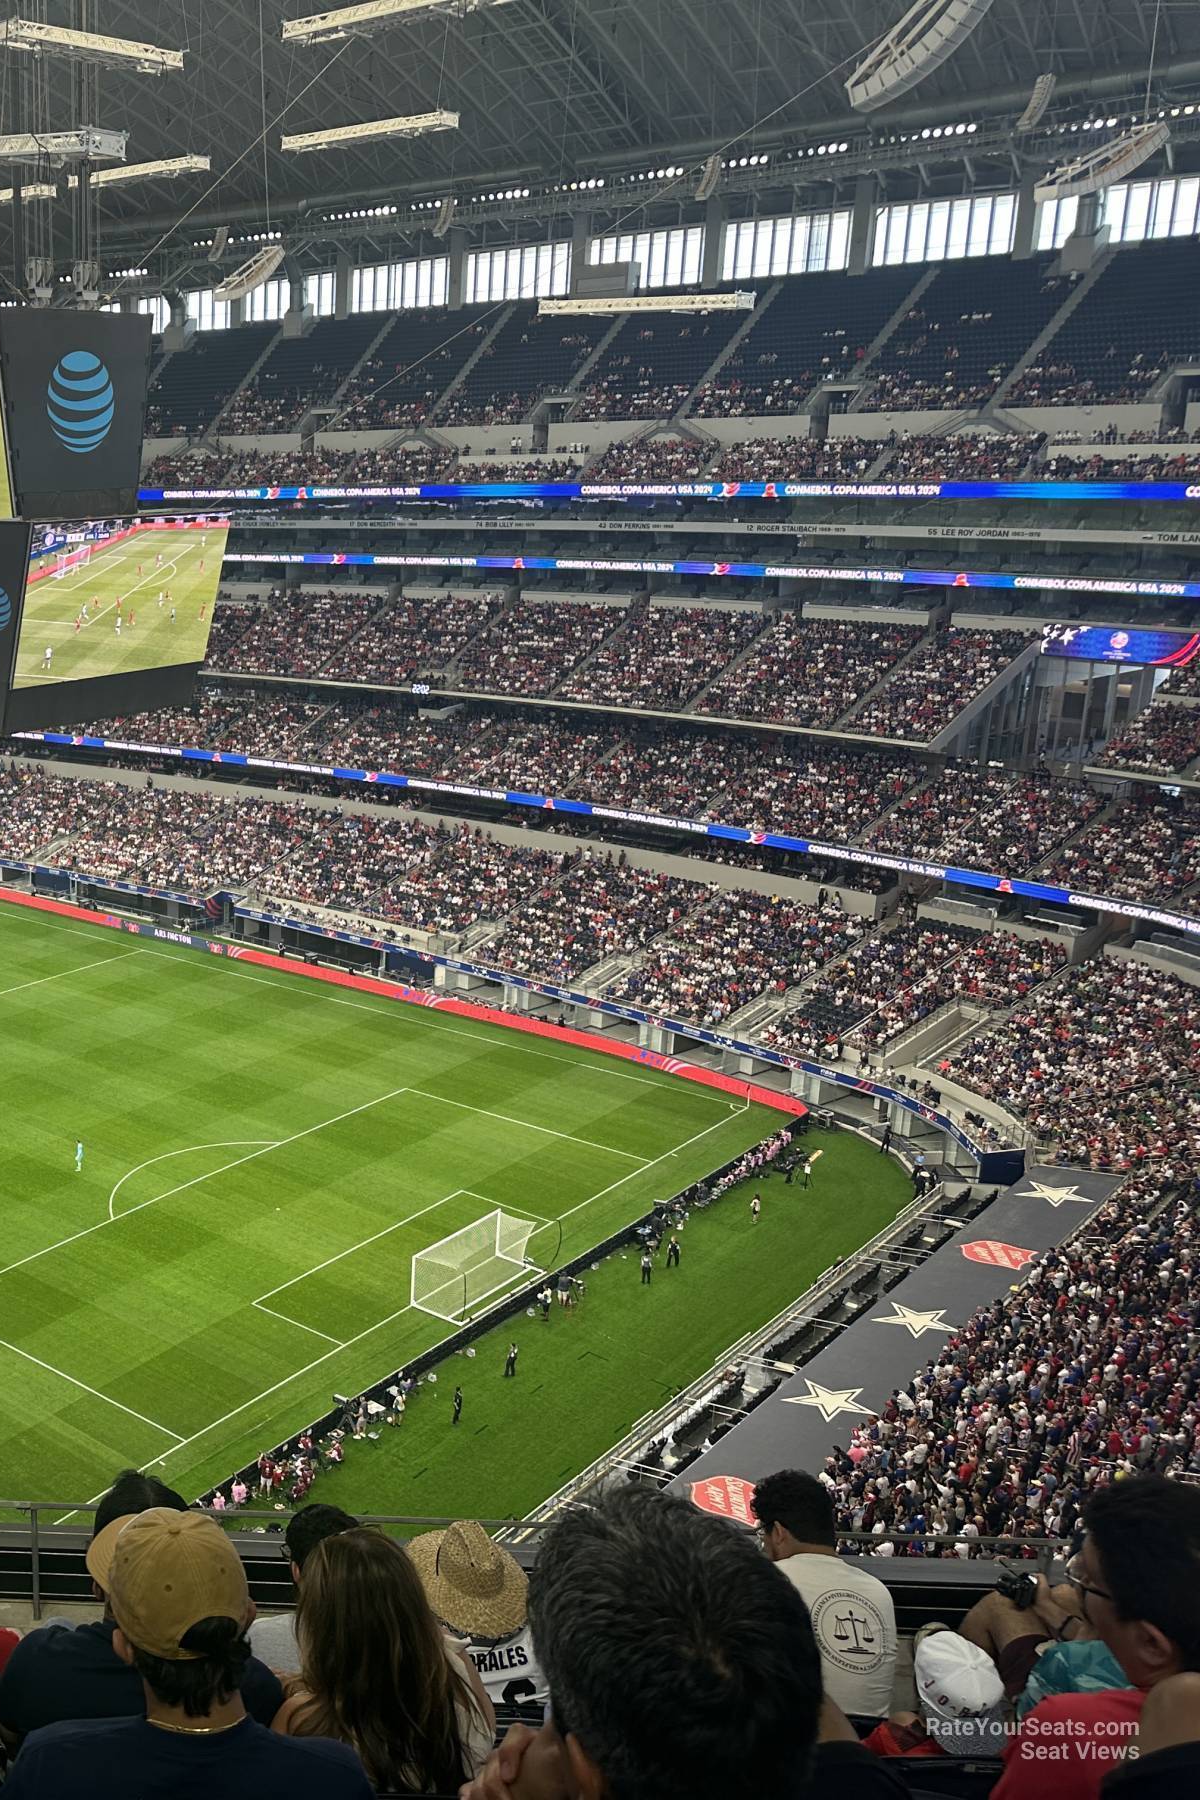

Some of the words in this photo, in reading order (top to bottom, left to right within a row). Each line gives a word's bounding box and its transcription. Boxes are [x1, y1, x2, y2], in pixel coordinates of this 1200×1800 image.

[580, 485, 622, 495] CONMEBOL
[622, 485, 642, 495] COPA
[641, 485, 677, 495] AMERICA
[678, 485, 694, 495] USA
[694, 485, 714, 495] 2024
[784, 485, 833, 495] CONMEBOL
[833, 485, 856, 495] COPA
[855, 485, 897, 495] AMERICA
[898, 485, 916, 495] USA
[917, 485, 941, 495] 2024
[781, 525, 818, 533] STAUBACH
[927, 528, 938, 536] 55
[941, 528, 957, 536] LEE
[958, 529, 974, 537] ROY
[975, 529, 1010, 537] JORDAN
[1157, 534, 1179, 542] TOM
[765, 567, 809, 577] CONMEBOL
[830, 569, 866, 579] AMERICA
[866, 571, 883, 580] USA
[883, 572, 904, 581] 2024
[1014, 577, 1066, 588] CONMEBOL
[1065, 579, 1091, 590] COPA
[1089, 580, 1137, 593] AMERICA
[1138, 583, 1158, 594] USA
[1159, 583, 1185, 595] 2024
[808, 844, 851, 860] CONMEBOL
[851, 852, 872, 864] COPA
[871, 856, 908, 871] AMERICA
[909, 862, 925, 874] USA
[925, 866, 946, 878] 2024
[1068, 894, 1122, 914] CONMEBOL
[1121, 903, 1150, 919] COPA
[1148, 910, 1187, 931] AMERICA
[154, 928, 192, 945] ARLINGTON
[704, 1482, 728, 1512] ARMY
[725, 1477, 749, 1521] SALVATION
